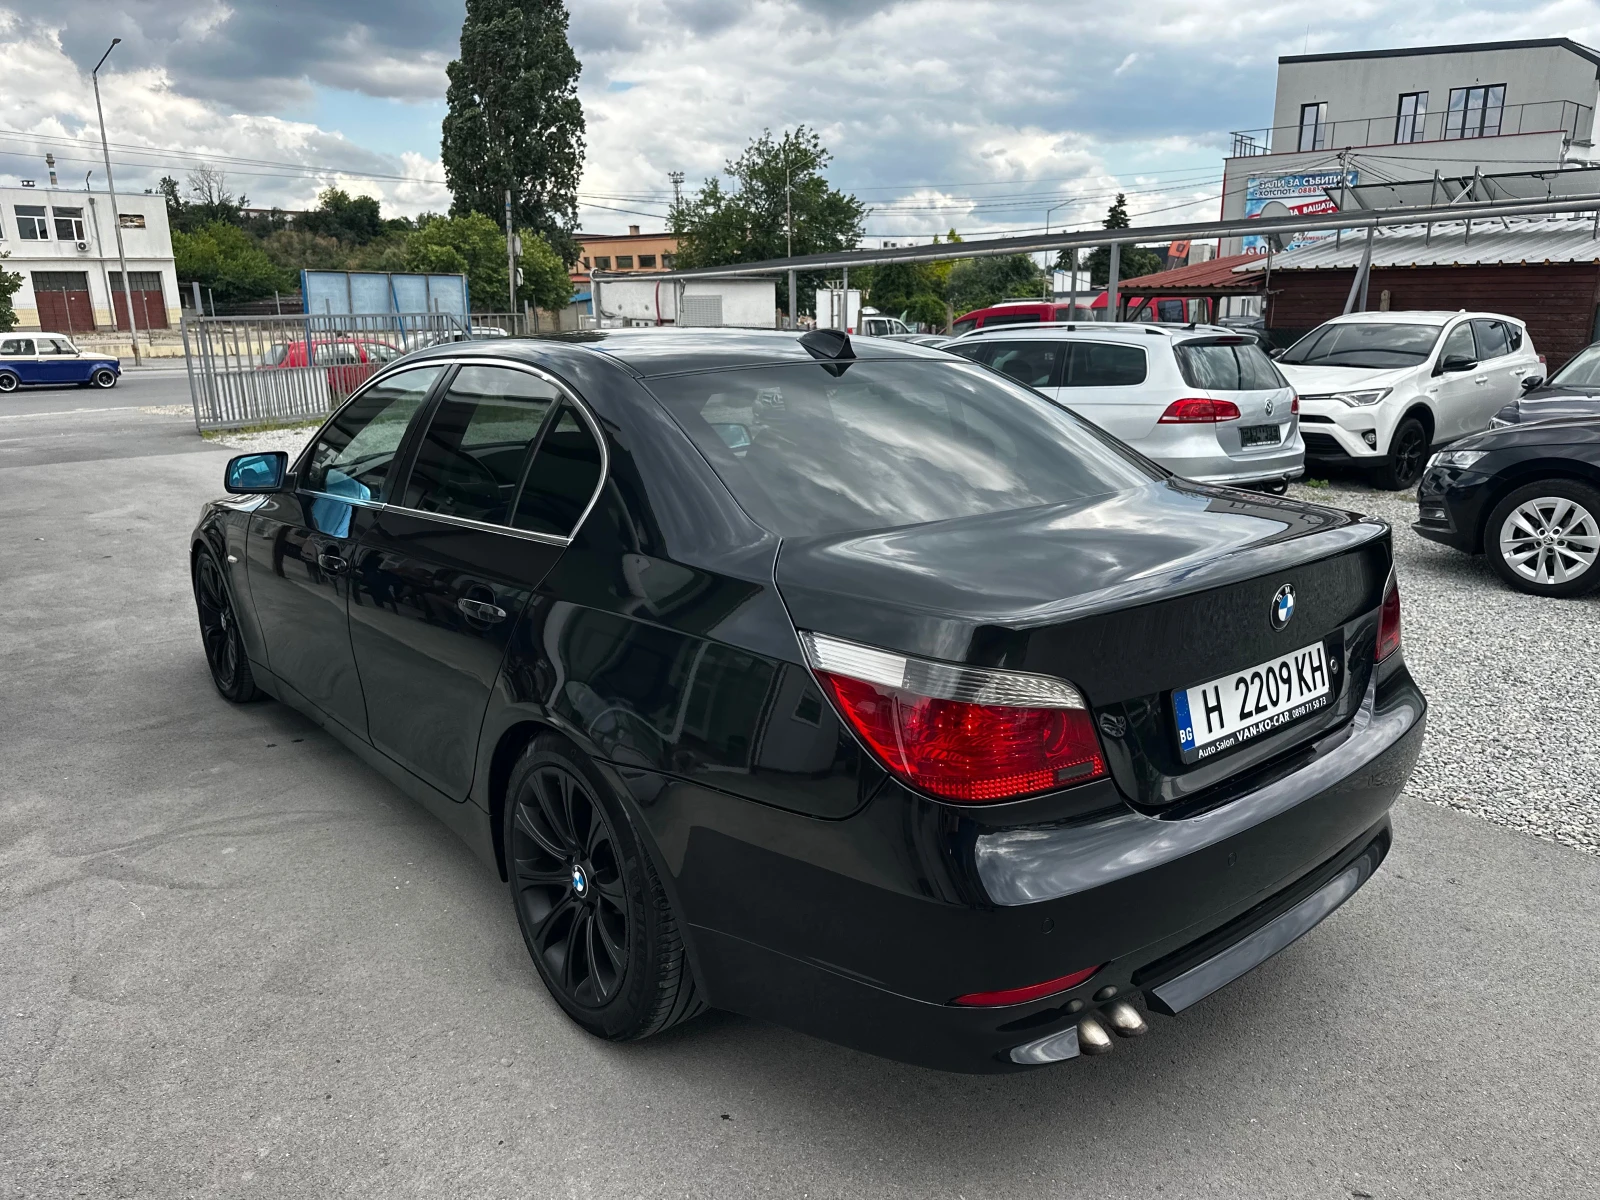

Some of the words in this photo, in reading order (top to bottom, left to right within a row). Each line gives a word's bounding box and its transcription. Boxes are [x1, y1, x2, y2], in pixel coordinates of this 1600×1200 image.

[1259, 180, 1285, 189] ЗАЛИ
[1287, 178, 1300, 187] ЗА
[1297, 186, 1317, 194] 0888
[1303, 201, 1335, 214] ВАШАТА
[1277, 586, 1296, 602] BMW
[1235, 661, 1292, 722] 2209
[1294, 647, 1326, 697] KH
[1179, 727, 1193, 743] BG
[1198, 744, 1216, 759] Auto
[1215, 737, 1235, 752] Salon
[1235, 711, 1290, 742] VAN-KO-CAR
